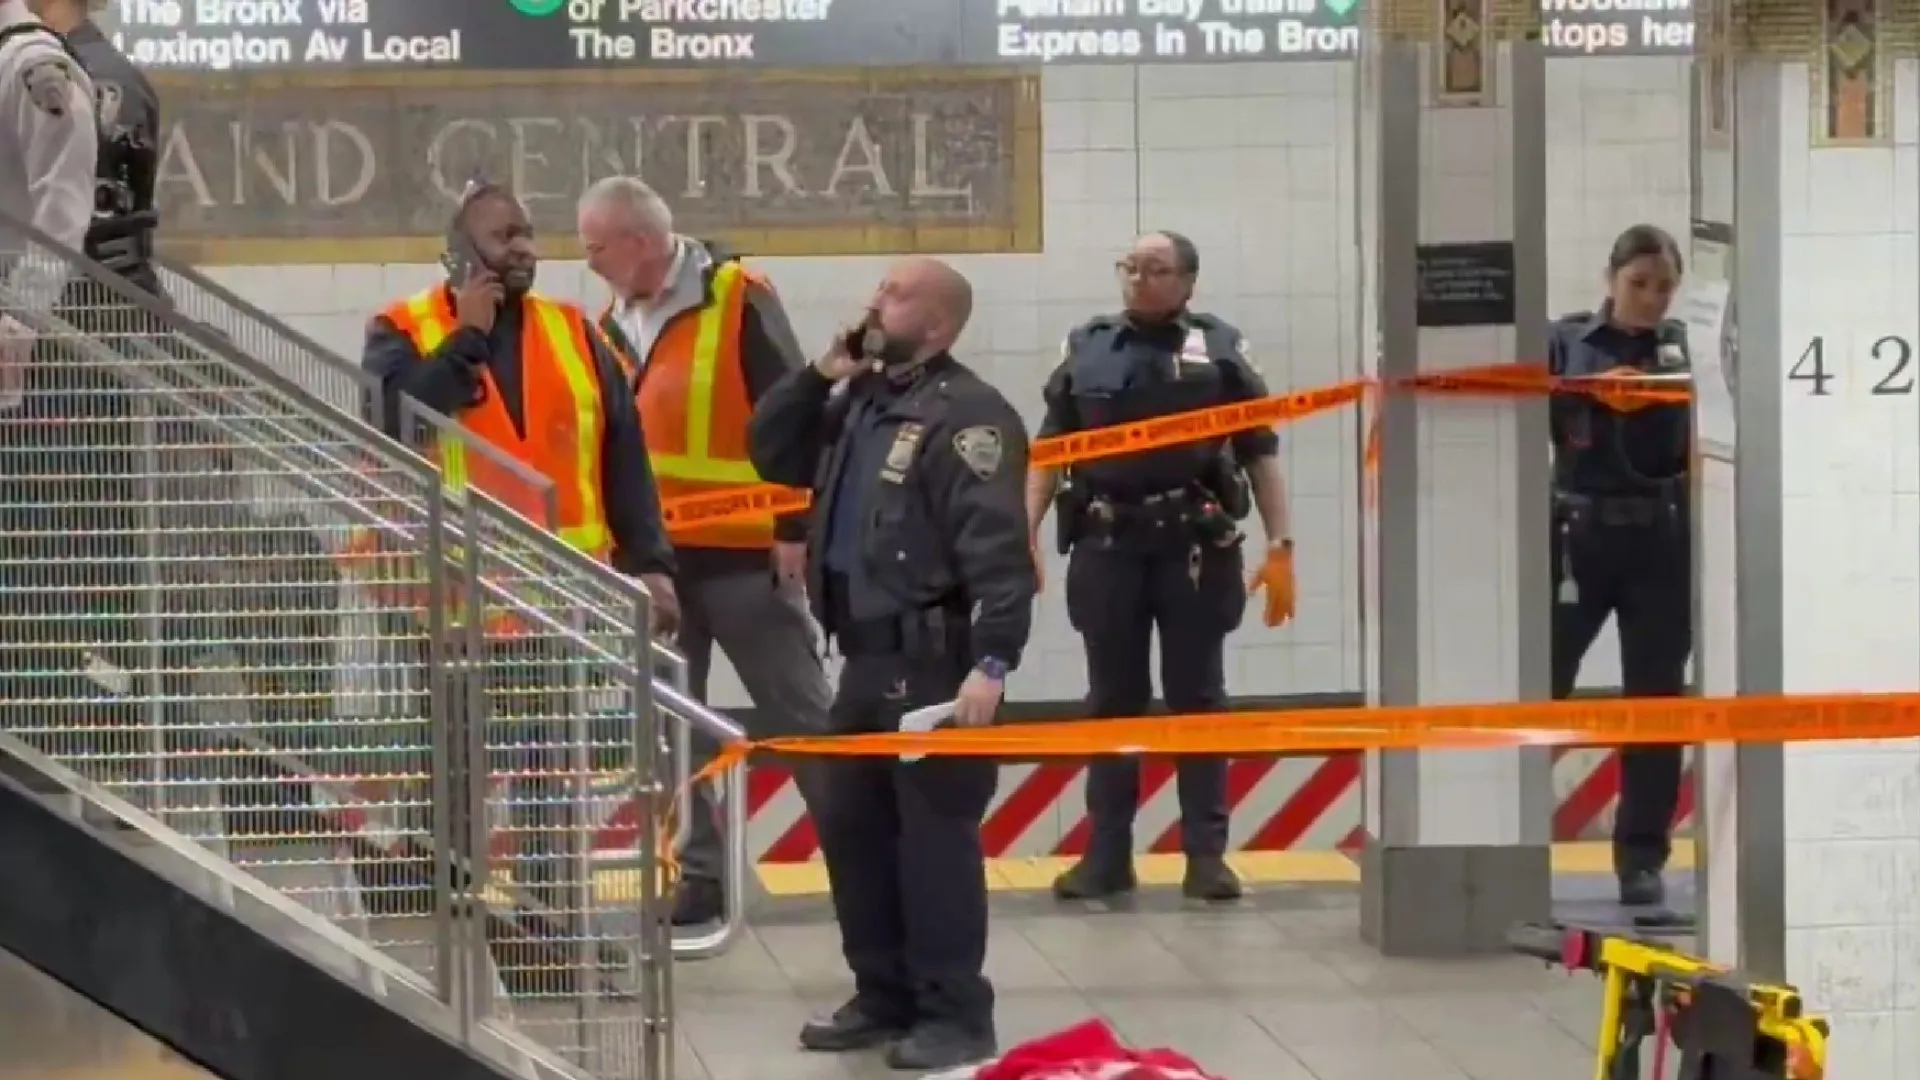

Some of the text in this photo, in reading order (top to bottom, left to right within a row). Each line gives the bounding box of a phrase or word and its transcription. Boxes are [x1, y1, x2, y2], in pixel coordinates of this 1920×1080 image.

[196, 0, 302, 25] Bronx
[619, 0, 832, 21] Parkchester
[112, 28, 462, 69] Lexington Av Local
[568, 27, 755, 59] The Bronx
[998, 23, 1141, 61] Express
[1198, 20, 1264, 54] The
[427, 114, 972, 207] CENTRAL
